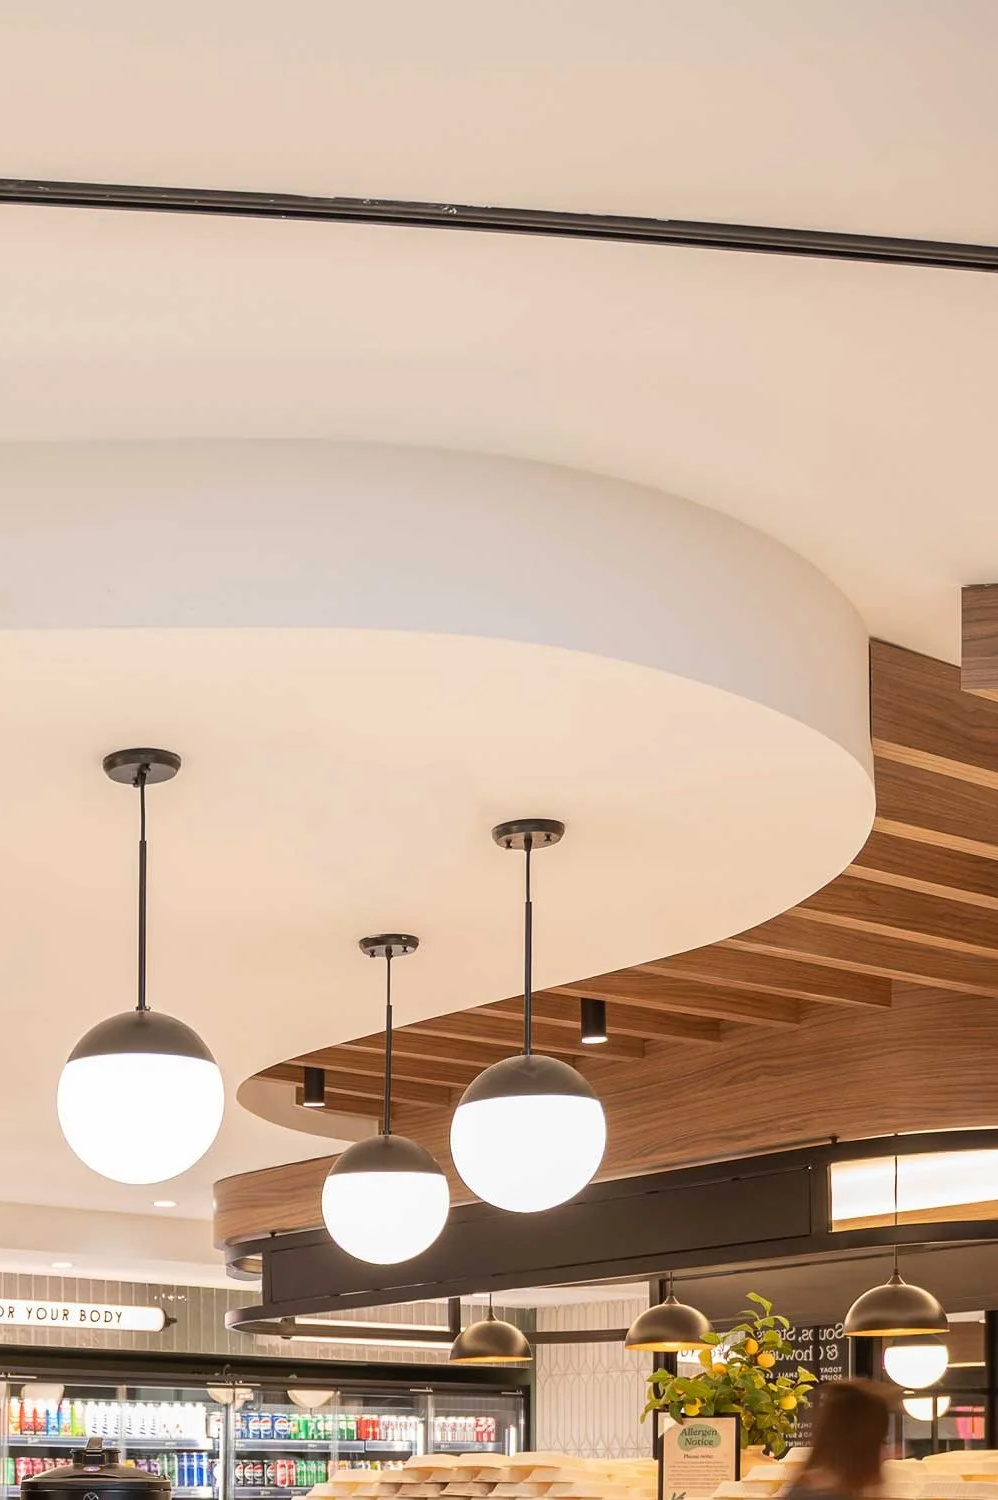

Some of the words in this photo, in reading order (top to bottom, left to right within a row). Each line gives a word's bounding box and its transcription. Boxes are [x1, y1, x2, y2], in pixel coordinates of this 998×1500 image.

[26, 1307, 69, 1321] YOUR
[79, 1309, 123, 1324] BODY
[681, 1428, 718, 1437] Allergen
[684, 1438, 714, 1446] Notice
